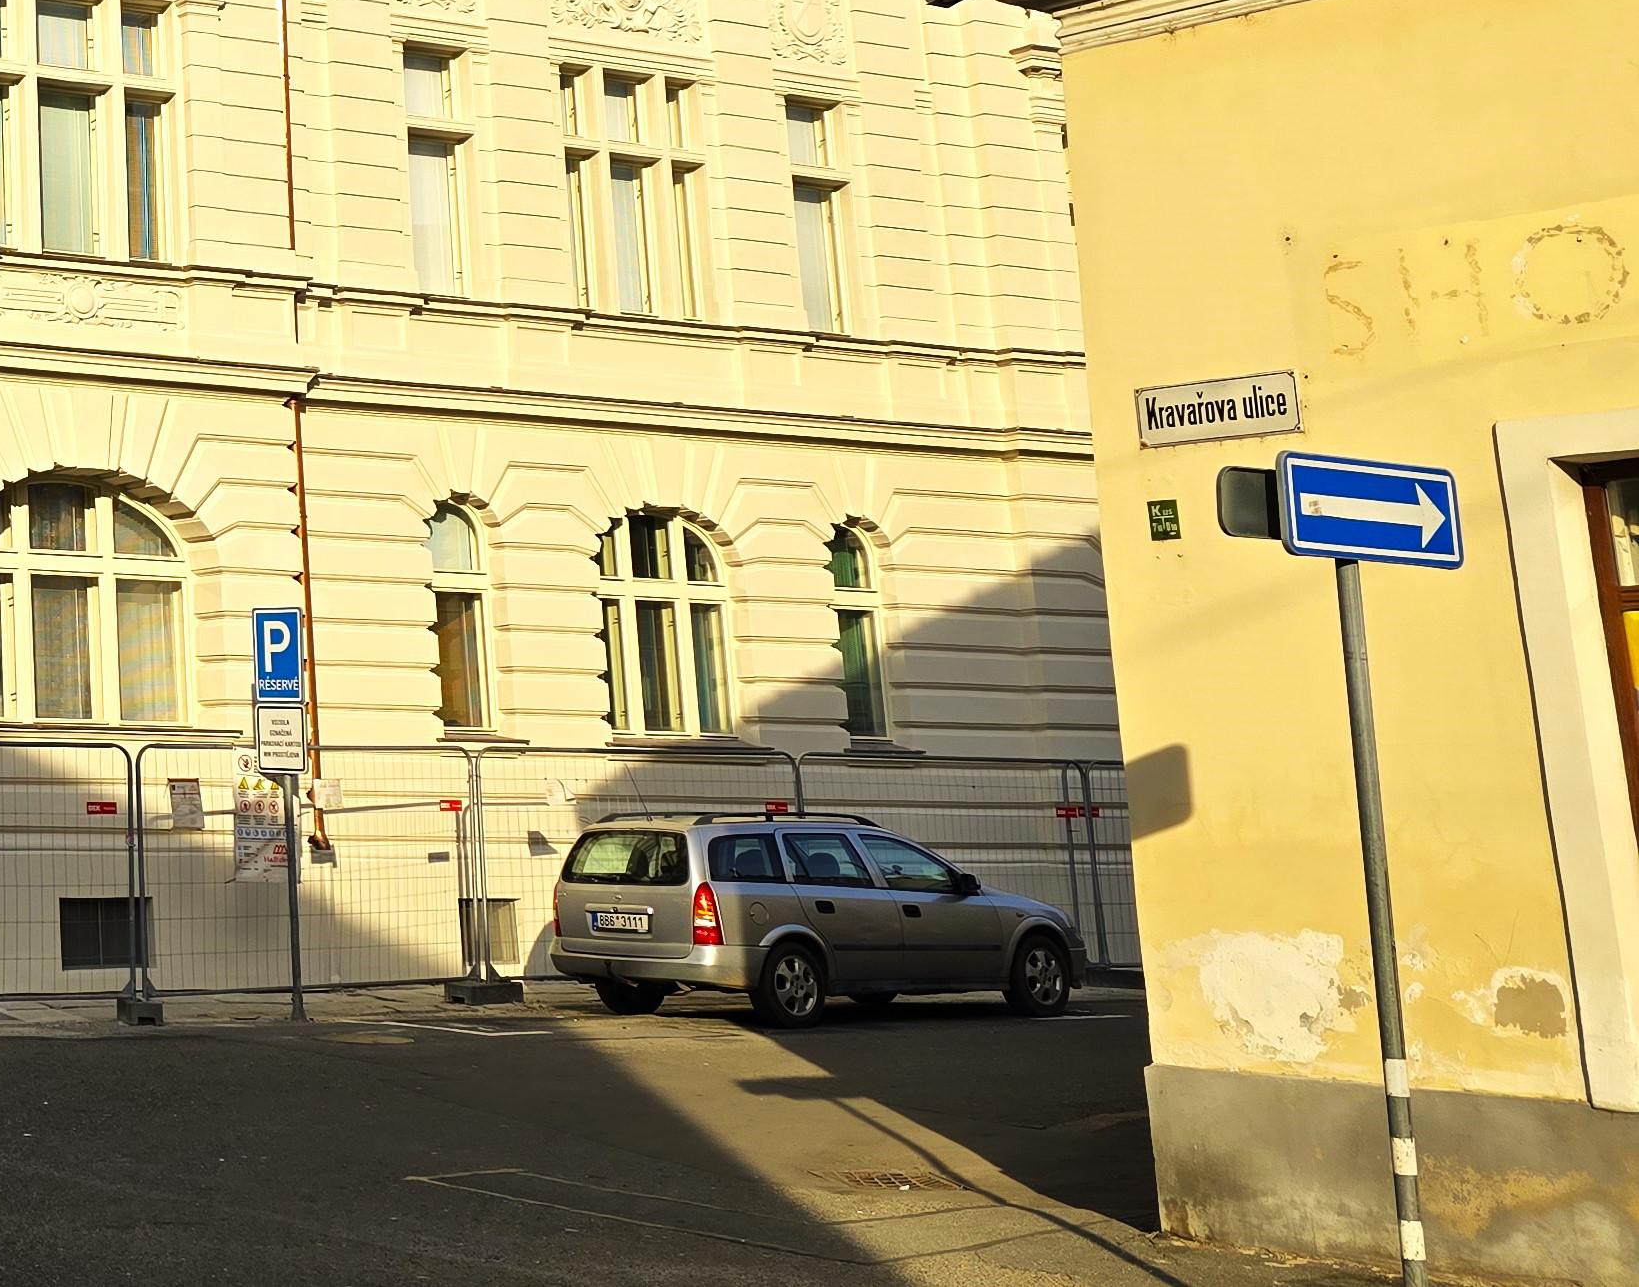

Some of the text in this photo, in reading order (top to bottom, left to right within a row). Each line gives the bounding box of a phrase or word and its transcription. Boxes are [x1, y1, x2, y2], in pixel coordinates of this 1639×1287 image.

[1145, 384, 1288, 431] Kravařova ulice
[263, 620, 291, 673] P
[259, 675, 300, 691] RÉSERVÉ
[621, 916, 643, 928] 3111
